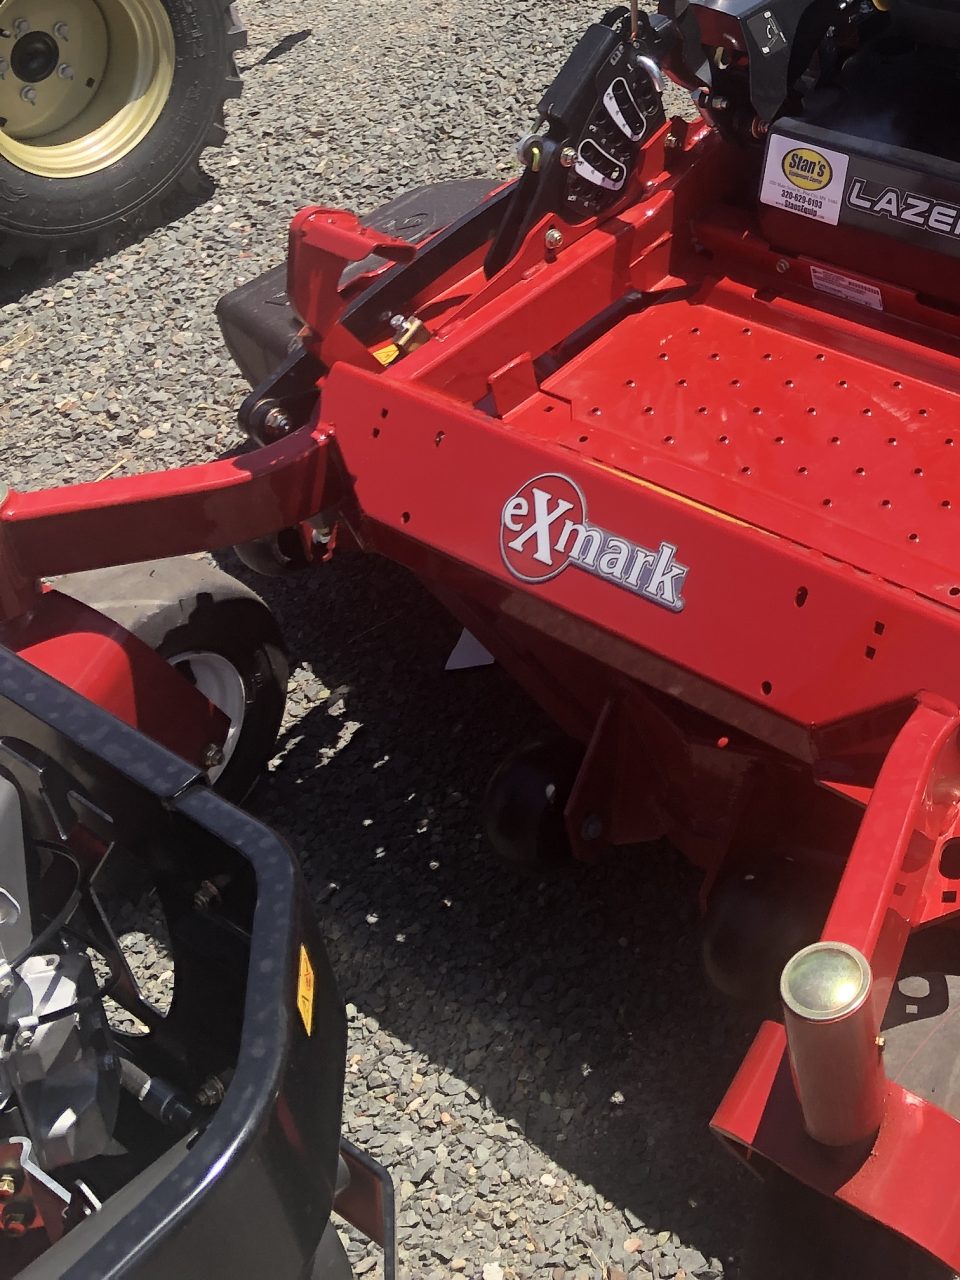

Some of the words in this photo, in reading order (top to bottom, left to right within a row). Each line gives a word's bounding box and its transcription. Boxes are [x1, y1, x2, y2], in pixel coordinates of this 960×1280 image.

[788, 152, 827, 178] Stan's
[781, 189, 823, 209] 320-629-6193
[503, 487, 687, 604] eXmark
